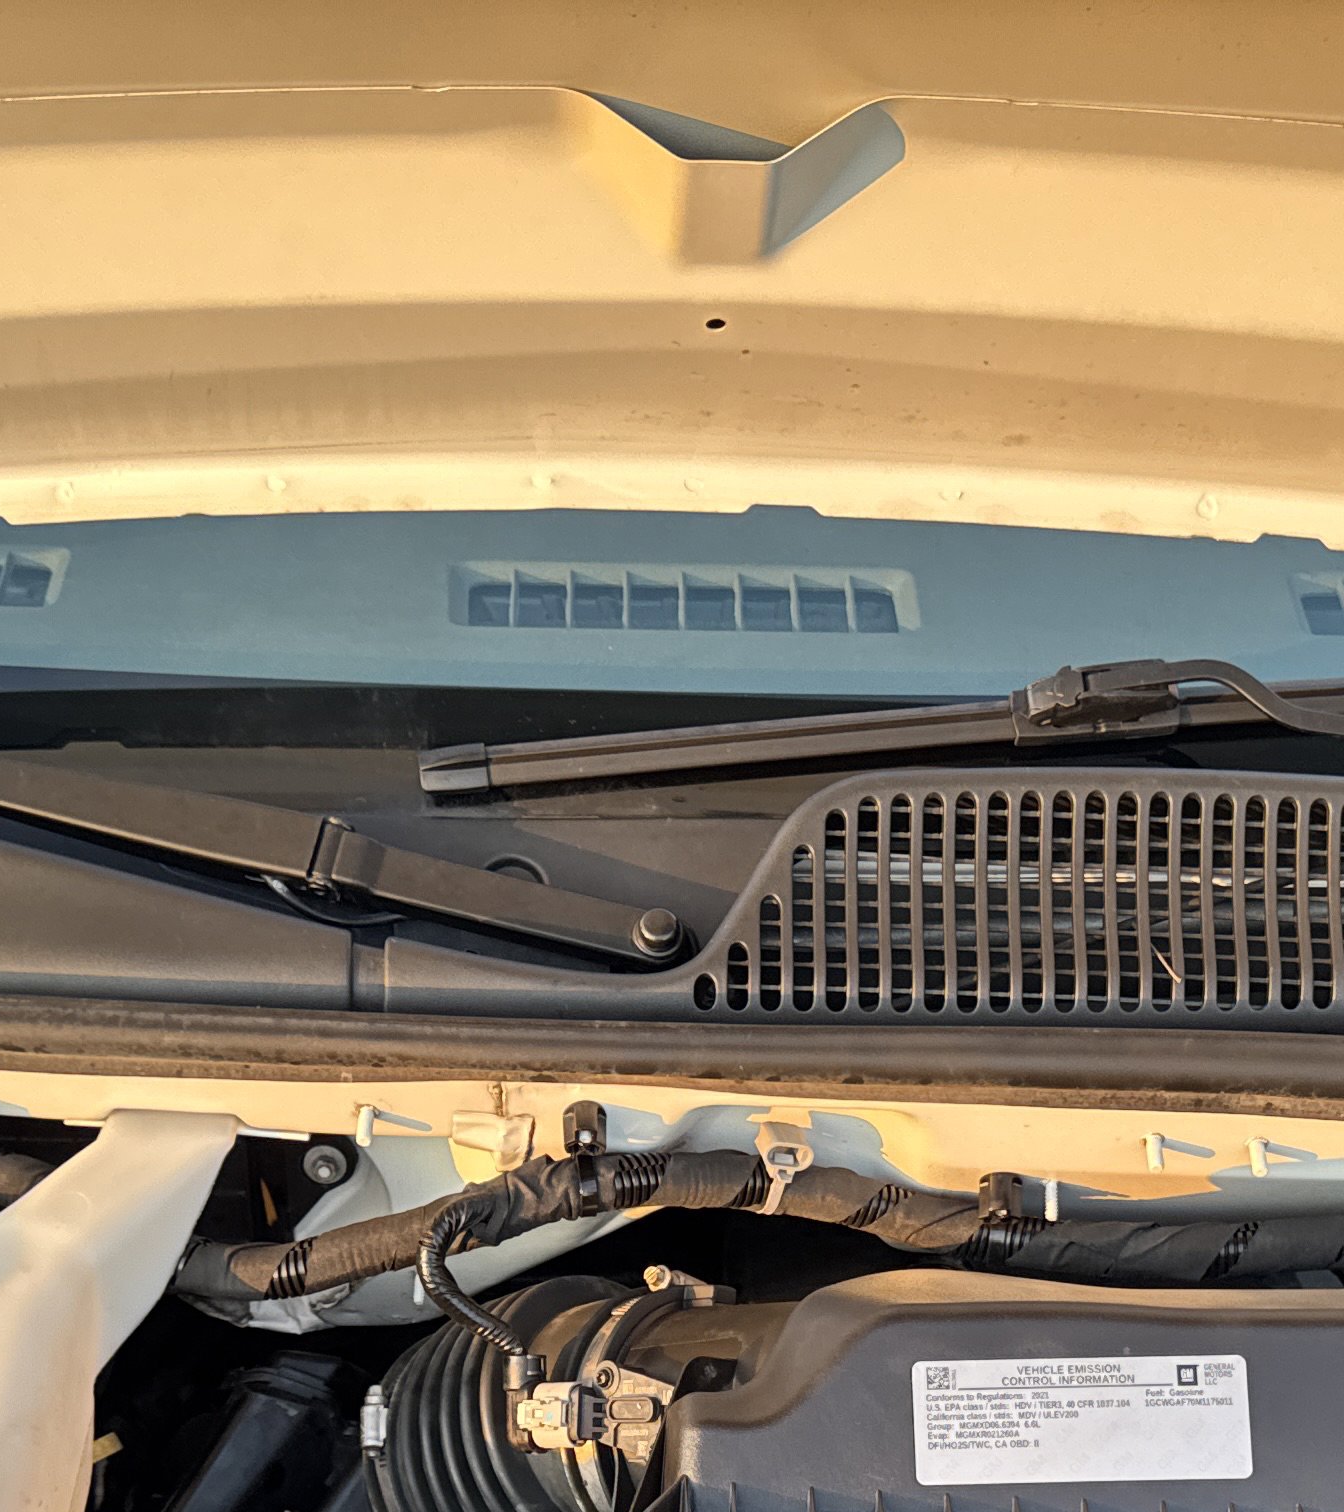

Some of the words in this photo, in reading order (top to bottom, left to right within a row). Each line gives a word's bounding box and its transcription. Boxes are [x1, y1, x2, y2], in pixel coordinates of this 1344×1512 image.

[1017, 1365, 1064, 1375] VEHICLE
[1068, 1364, 1121, 1374] EMISSION
[1002, 1377, 1055, 1385] CONTROL
[1058, 1374, 1135, 1385] INFORMATION
[926, 1394, 964, 1402] Conforms
[977, 1393, 1026, 1402] Regulations:
[945, 1403, 960, 1411] EPA
[1015, 1401, 1032, 1409] HDV
[1077, 1400, 1094, 1408] CFR
[927, 1413, 965, 1421] California
[927, 1423, 954, 1432] Group:
[928, 1433, 949, 1442] Evap:
[995, 1440, 1007, 1448] CA
